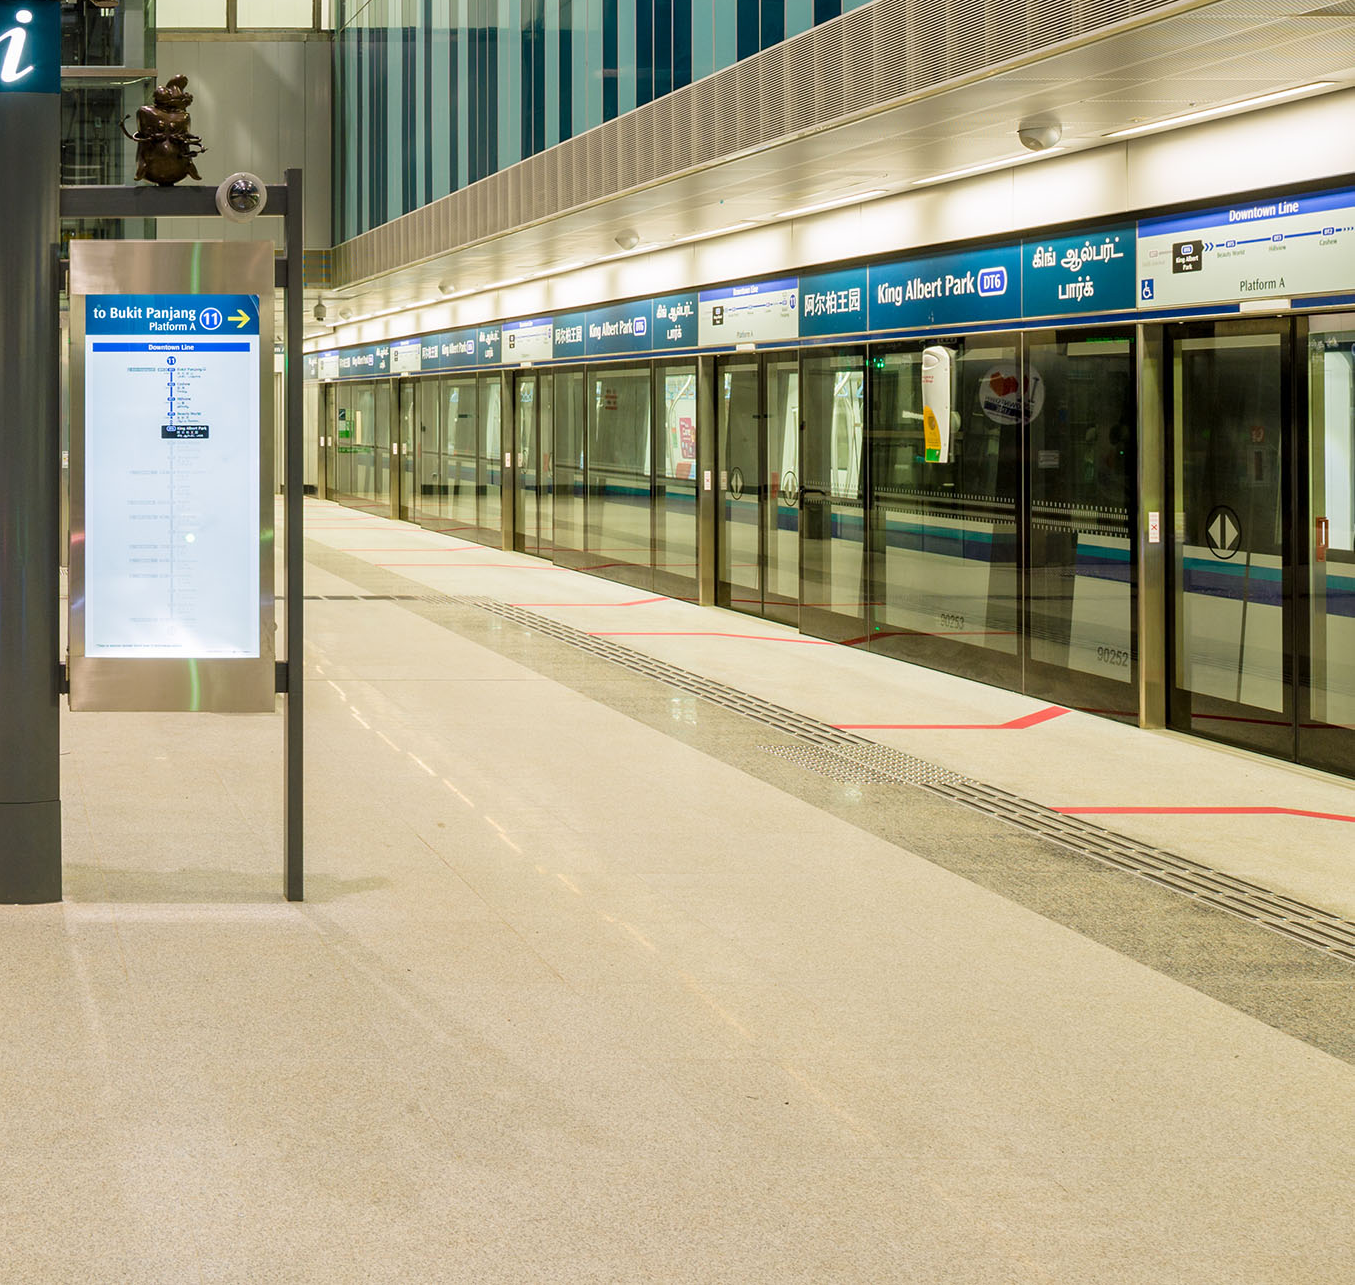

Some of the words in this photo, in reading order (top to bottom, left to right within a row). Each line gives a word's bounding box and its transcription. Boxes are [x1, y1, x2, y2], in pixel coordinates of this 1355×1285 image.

[1229, 206, 1276, 222] Downtown
[1278, 201, 1300, 215] Line
[1319, 238, 1338, 246] Cashew
[1032, 245, 1056, 269] கிங்
[1060, 236, 1124, 272] ஆல்பர்ட்
[1176, 256, 1185, 264] King
[1182, 263, 1193, 271] Park
[877, 282, 903, 307] King
[904, 277, 942, 301] Albert
[945, 270, 975, 296] Park
[983, 273, 1002, 290] DT6
[1058, 275, 1095, 302] பார்க்
[1240, 278, 1277, 292] Platform
[1279, 276, 1286, 288] A
[804, 287, 861, 318] 阿尔柏王园
[93, 307, 106, 319] to
[110, 306, 143, 319] Bukit
[146, 306, 197, 321] Panjang
[203, 312, 218, 326] 11
[149, 321, 188, 331] Platform
[189, 322, 196, 331] A
[588, 323, 602, 341] King
[602, 321, 619, 337] Albert
[619, 319, 633, 334] Park
[181, 343, 195, 351] Line
[940, 613, 965, 630] 90253
[1097, 646, 1129, 667] 90252
